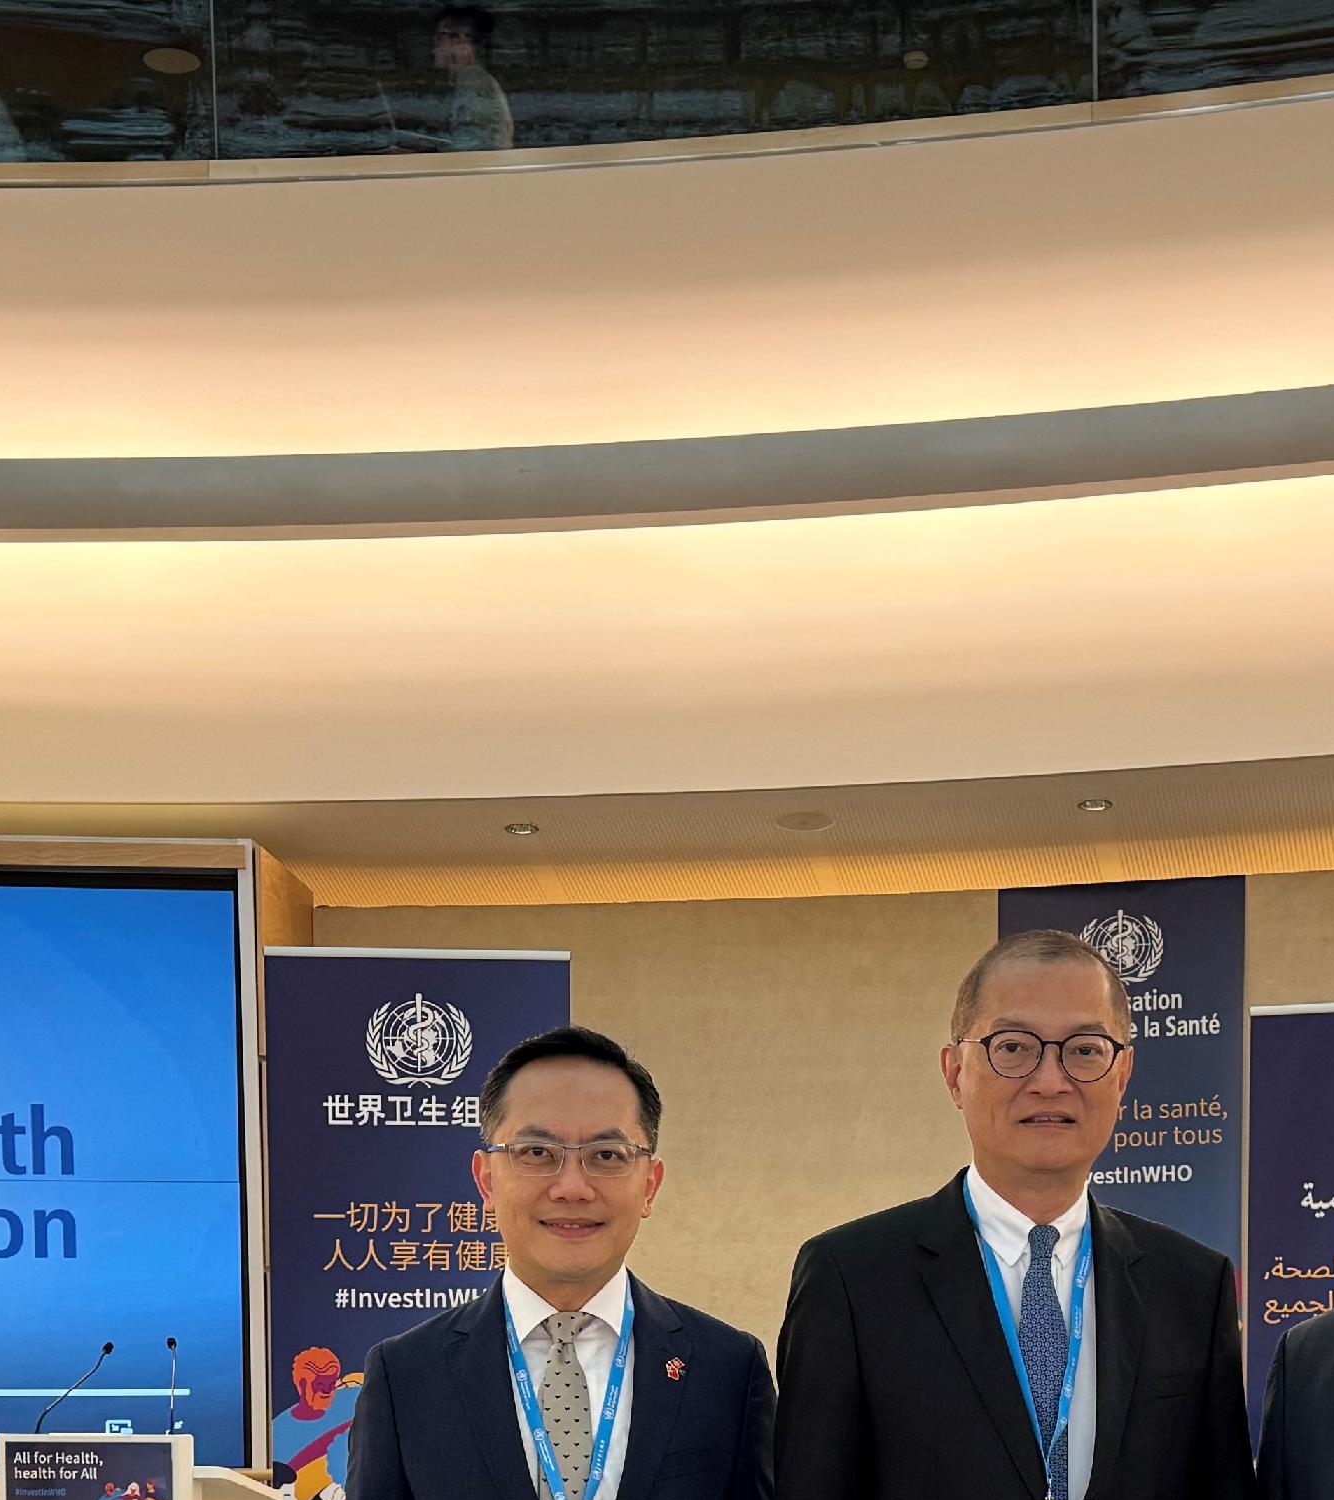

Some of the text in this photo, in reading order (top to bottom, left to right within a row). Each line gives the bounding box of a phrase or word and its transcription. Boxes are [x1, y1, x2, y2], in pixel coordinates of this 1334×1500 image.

[1144, 1015, 1160, 1038] la
[1165, 1012, 1221, 1037] Santé
[322, 1094, 482, 1127] 世界卫生组
[1133, 1099, 1153, 1120] la
[1159, 1094, 1228, 1120] santé,
[1114, 1126, 1223, 1153] pour tous
[13, 1451, 103, 1466] All for Health,
[14, 1466, 97, 1480] health for All
